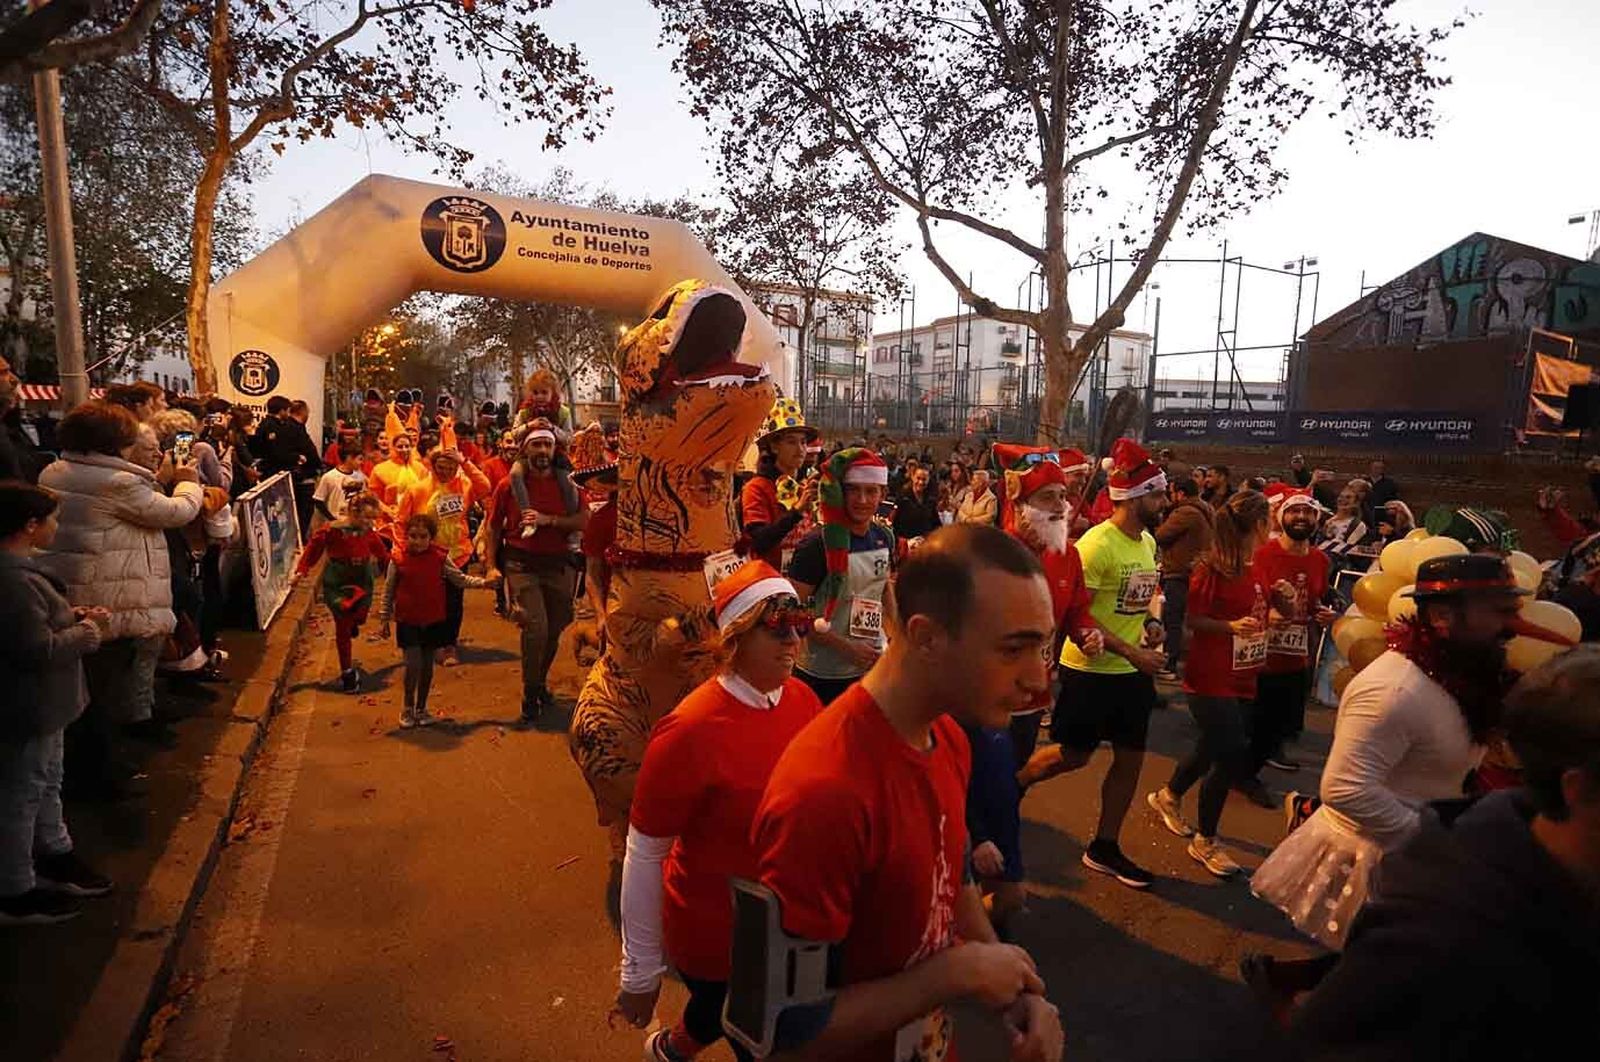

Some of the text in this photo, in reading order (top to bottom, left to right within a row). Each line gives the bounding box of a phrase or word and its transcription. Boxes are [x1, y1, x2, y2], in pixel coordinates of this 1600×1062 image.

[510, 210, 650, 240] Ayuntamiento
[552, 231, 650, 257] de Huelva
[583, 255, 599, 265] de
[601, 256, 652, 271] Deportes
[1170, 420, 1207, 428] HYUNDAI
[1233, 419, 1276, 428] HYUNDAI
[1319, 420, 1371, 430] HYUNDAI
[1409, 420, 1472, 431] HYUNDAI
[864, 611, 880, 628] 388
